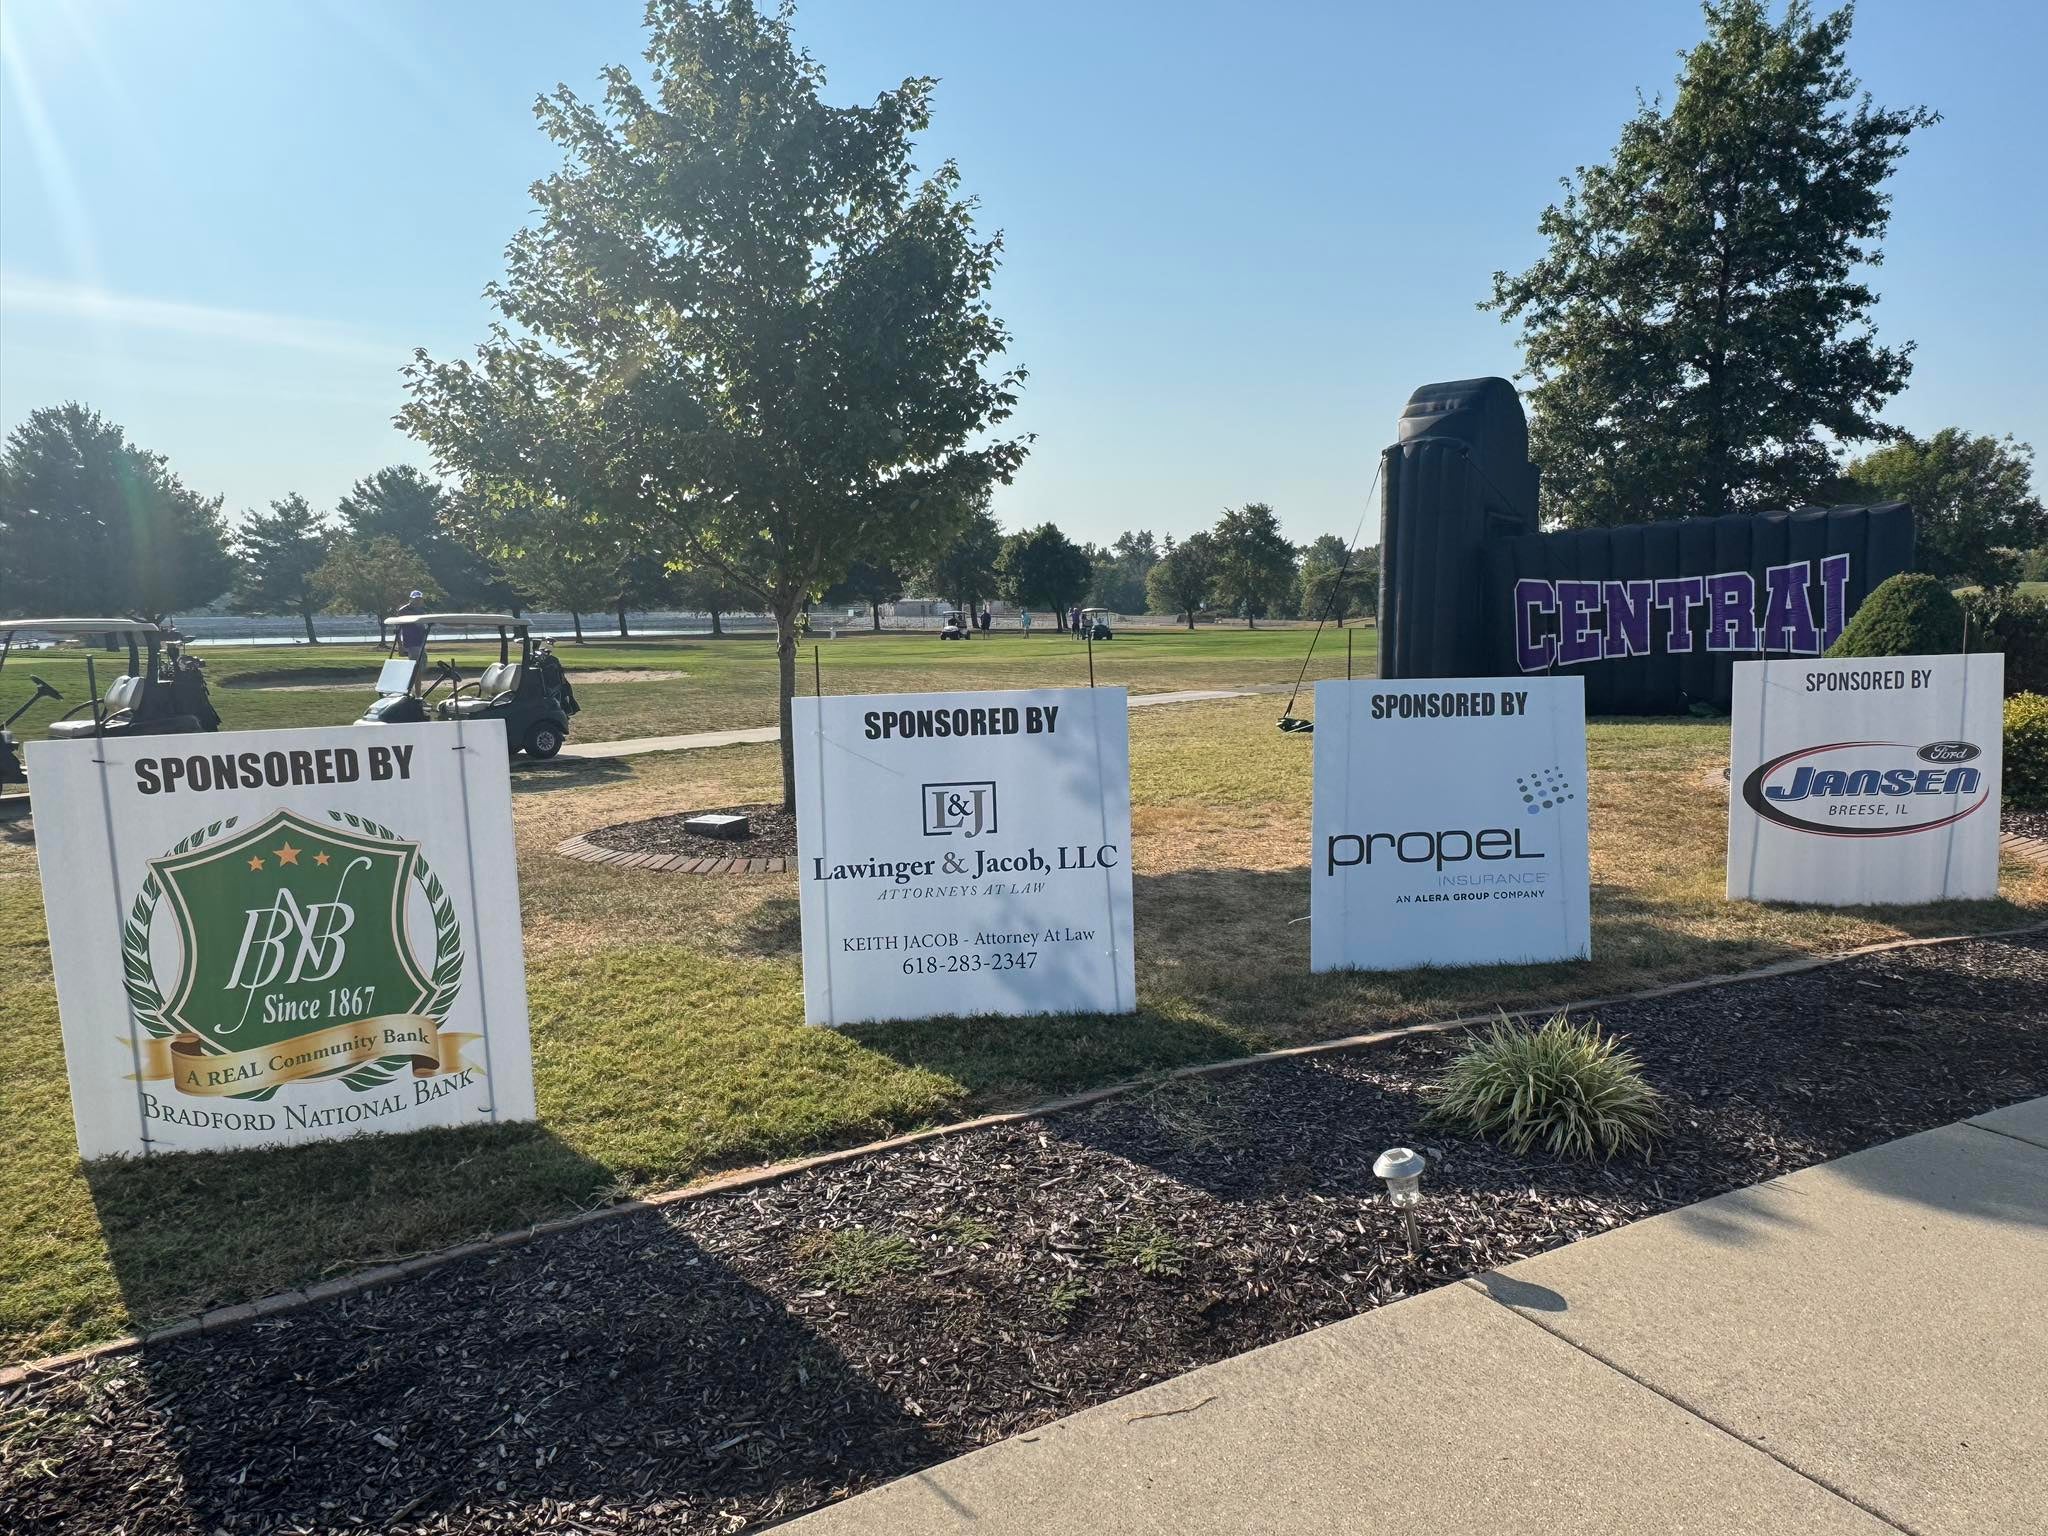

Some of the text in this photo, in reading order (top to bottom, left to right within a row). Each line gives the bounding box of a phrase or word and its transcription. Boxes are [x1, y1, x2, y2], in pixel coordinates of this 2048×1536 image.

[1806, 670, 1932, 692] SPONSORED BY
[1371, 691, 1528, 719] SPONSORED BY
[864, 706, 1059, 740] SPONSORED BY
[1930, 744, 1968, 760] Ford
[134, 745, 414, 795] SPONSORED BY
[931, 789, 987, 839] L&J
[1828, 804, 1909, 817] BREESE, IL
[813, 844, 1119, 885] Lawinger & Jacob, LLC
[876, 882, 1046, 901] ATTORNEYS AT LAW
[1438, 872, 1547, 887] INSURANCE
[1396, 889, 1545, 904] AN ALERA GROUP COMPANY
[843, 935, 898, 952] KEITH
[902, 933, 959, 951] JACOB
[974, 930, 1039, 948] Attorney
[1044, 929, 1061, 943] At
[1065, 928, 1096, 942] Law
[902, 952, 1038, 976] 618-283-2347
[262, 985, 376, 1024] Since 1867
[186, 1028, 431, 1087] A REAL Community Bank
[142, 1067, 475, 1131] BRADFORD NATIONAL BANK
